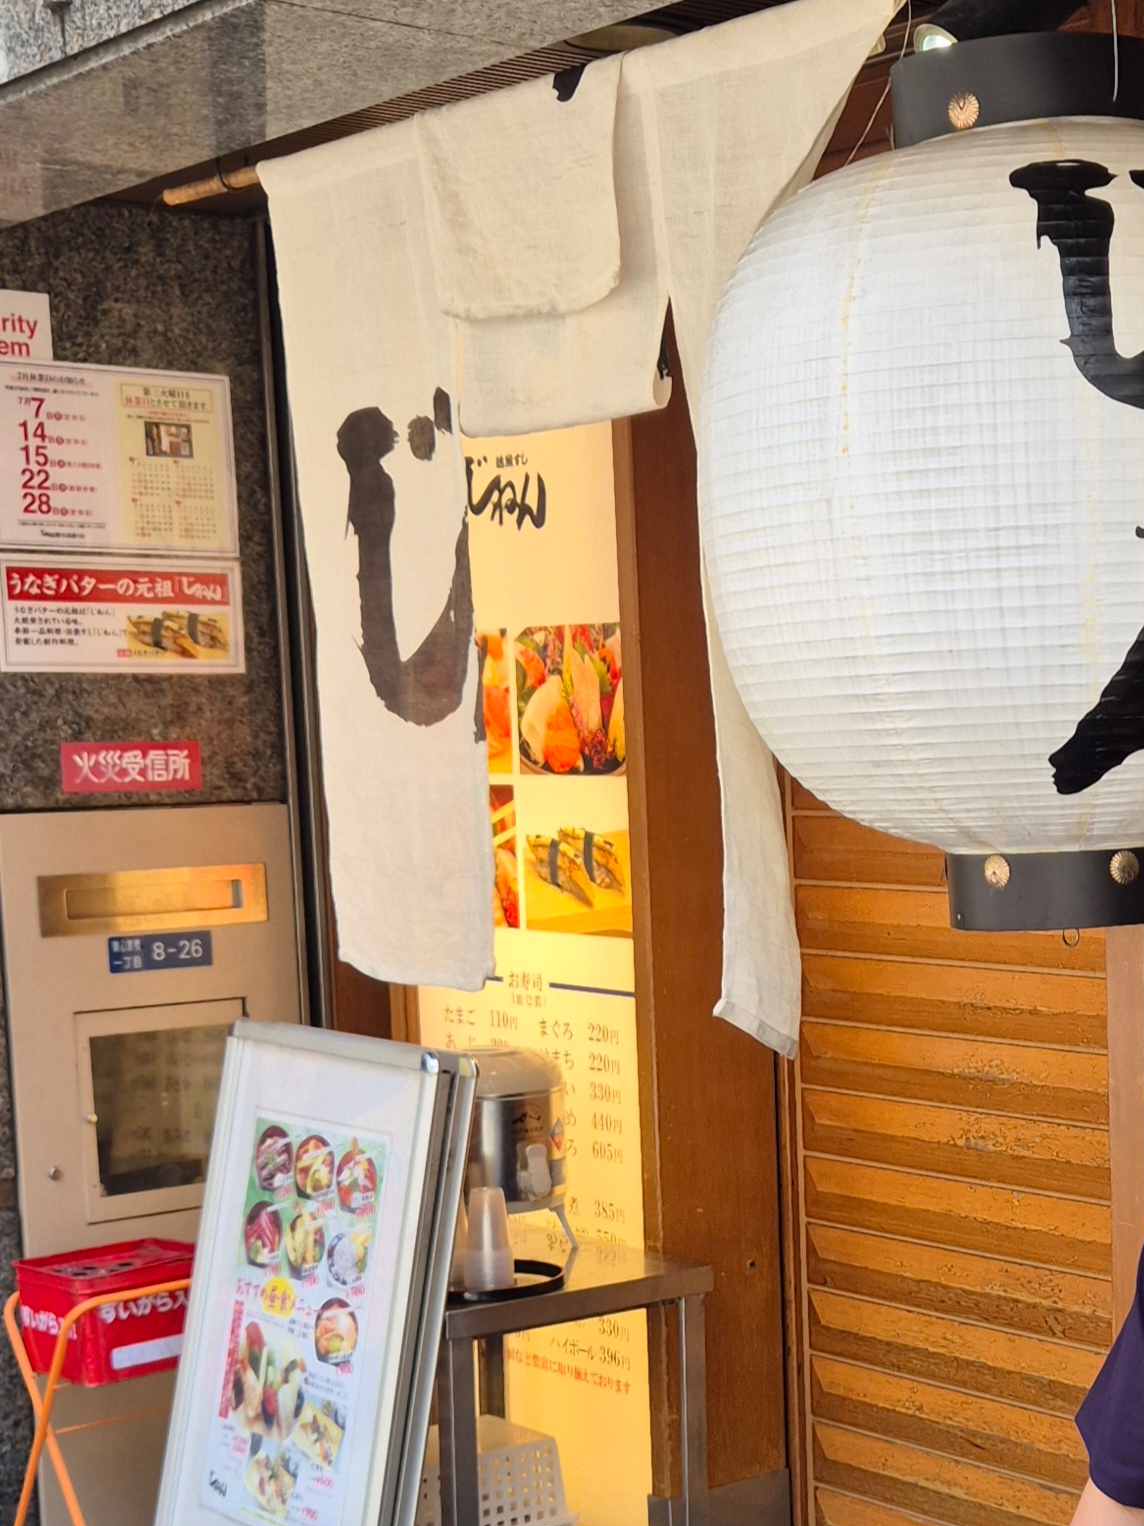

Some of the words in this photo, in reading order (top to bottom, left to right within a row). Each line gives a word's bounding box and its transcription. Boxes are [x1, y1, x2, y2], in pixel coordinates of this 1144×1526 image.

[18, 420, 47, 442] 14
[19, 445, 49, 467] 15
[21, 468, 51, 490] 22
[22, 492, 52, 515] 28
[73, 750, 191, 783] 火災受信所
[153, 940, 203, 961] 8-26
[508, 971, 543, 992] お寿司
[445, 1005, 476, 1026] たまご
[489, 1009, 518, 1031] 110円
[539, 1018, 573, 1041] まぐろ
[588, 1022, 620, 1046] 220円
[589, 1051, 621, 1075] 220円
[590, 1080, 622, 1105] 330円
[592, 1111, 623, 1135] 440円
[592, 1140, 624, 1164] 605円
[594, 1199, 626, 1223] 385円
[550, 1336, 596, 1361] ハイボール
[600, 1344, 631, 1371] 396円
